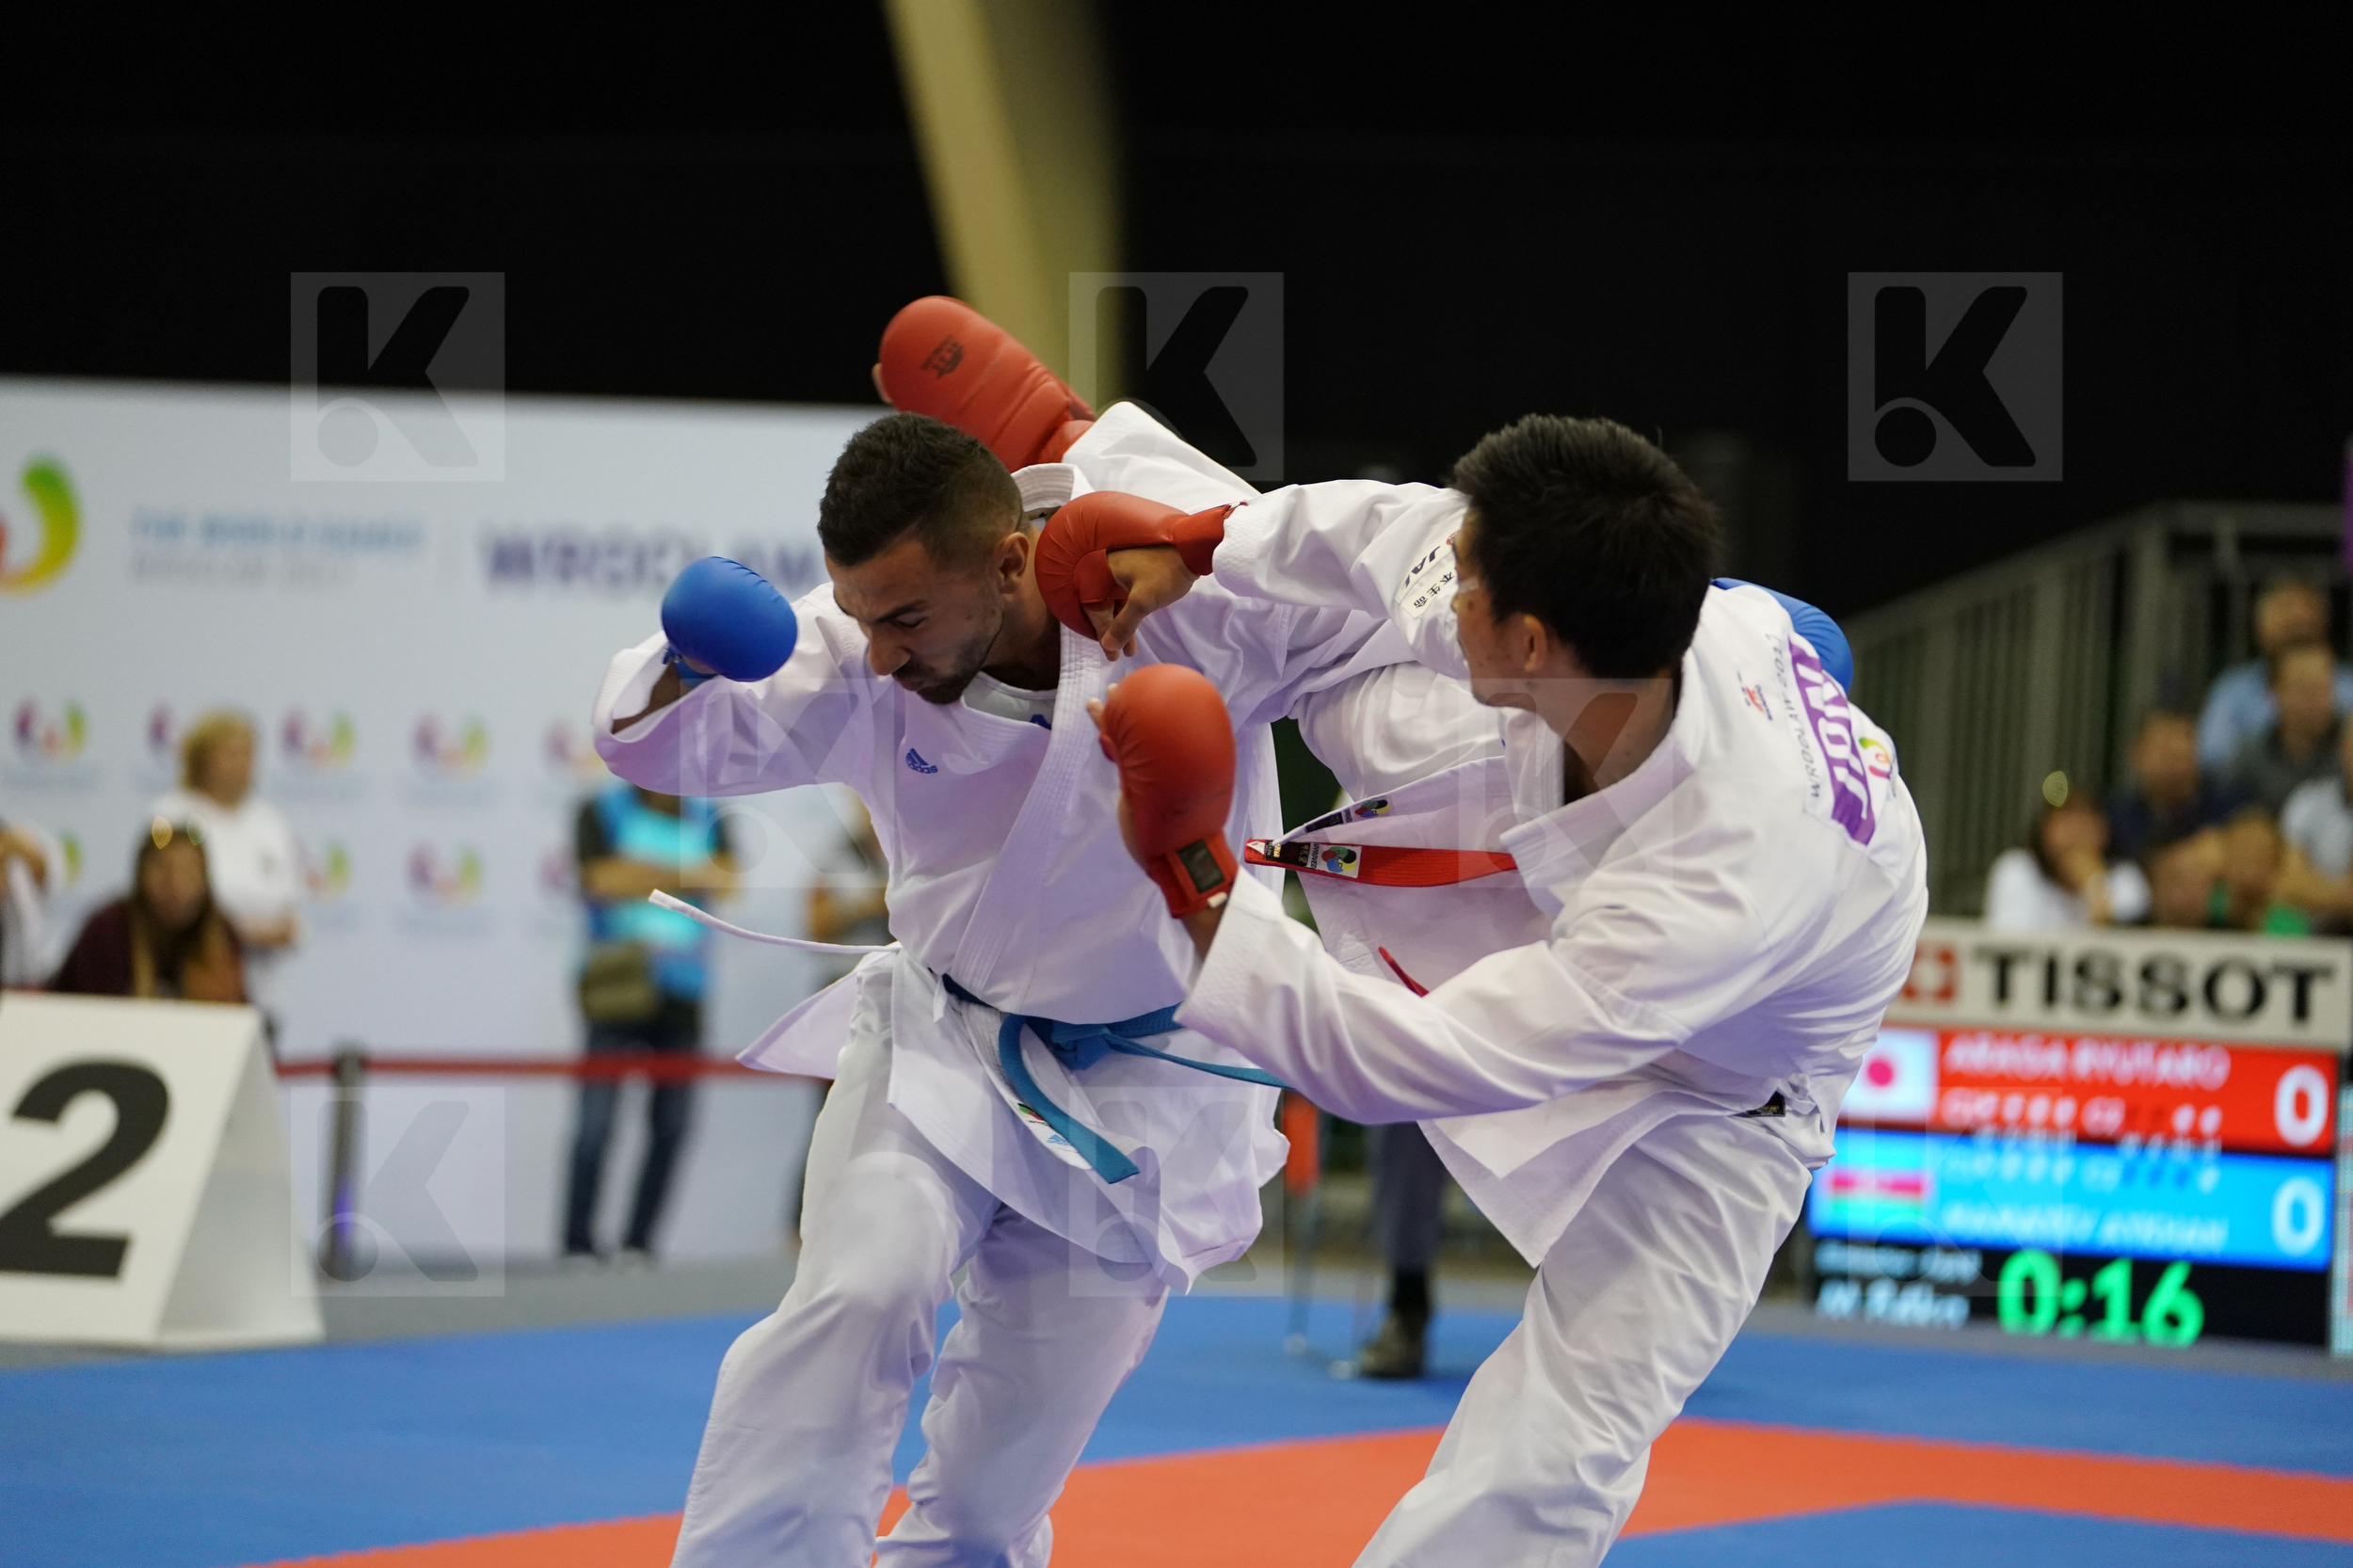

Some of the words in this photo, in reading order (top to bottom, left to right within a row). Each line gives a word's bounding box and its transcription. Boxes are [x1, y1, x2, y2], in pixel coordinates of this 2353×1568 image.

[1413, 568, 1456, 609] 本生命
[1975, 947, 2335, 1024] TISSOT
[2273, 1063, 2329, 1147] 0
[0, 1058, 170, 1279] 2
[2270, 1176, 2327, 1256] 0
[1995, 1246, 2205, 1350] 0:16
